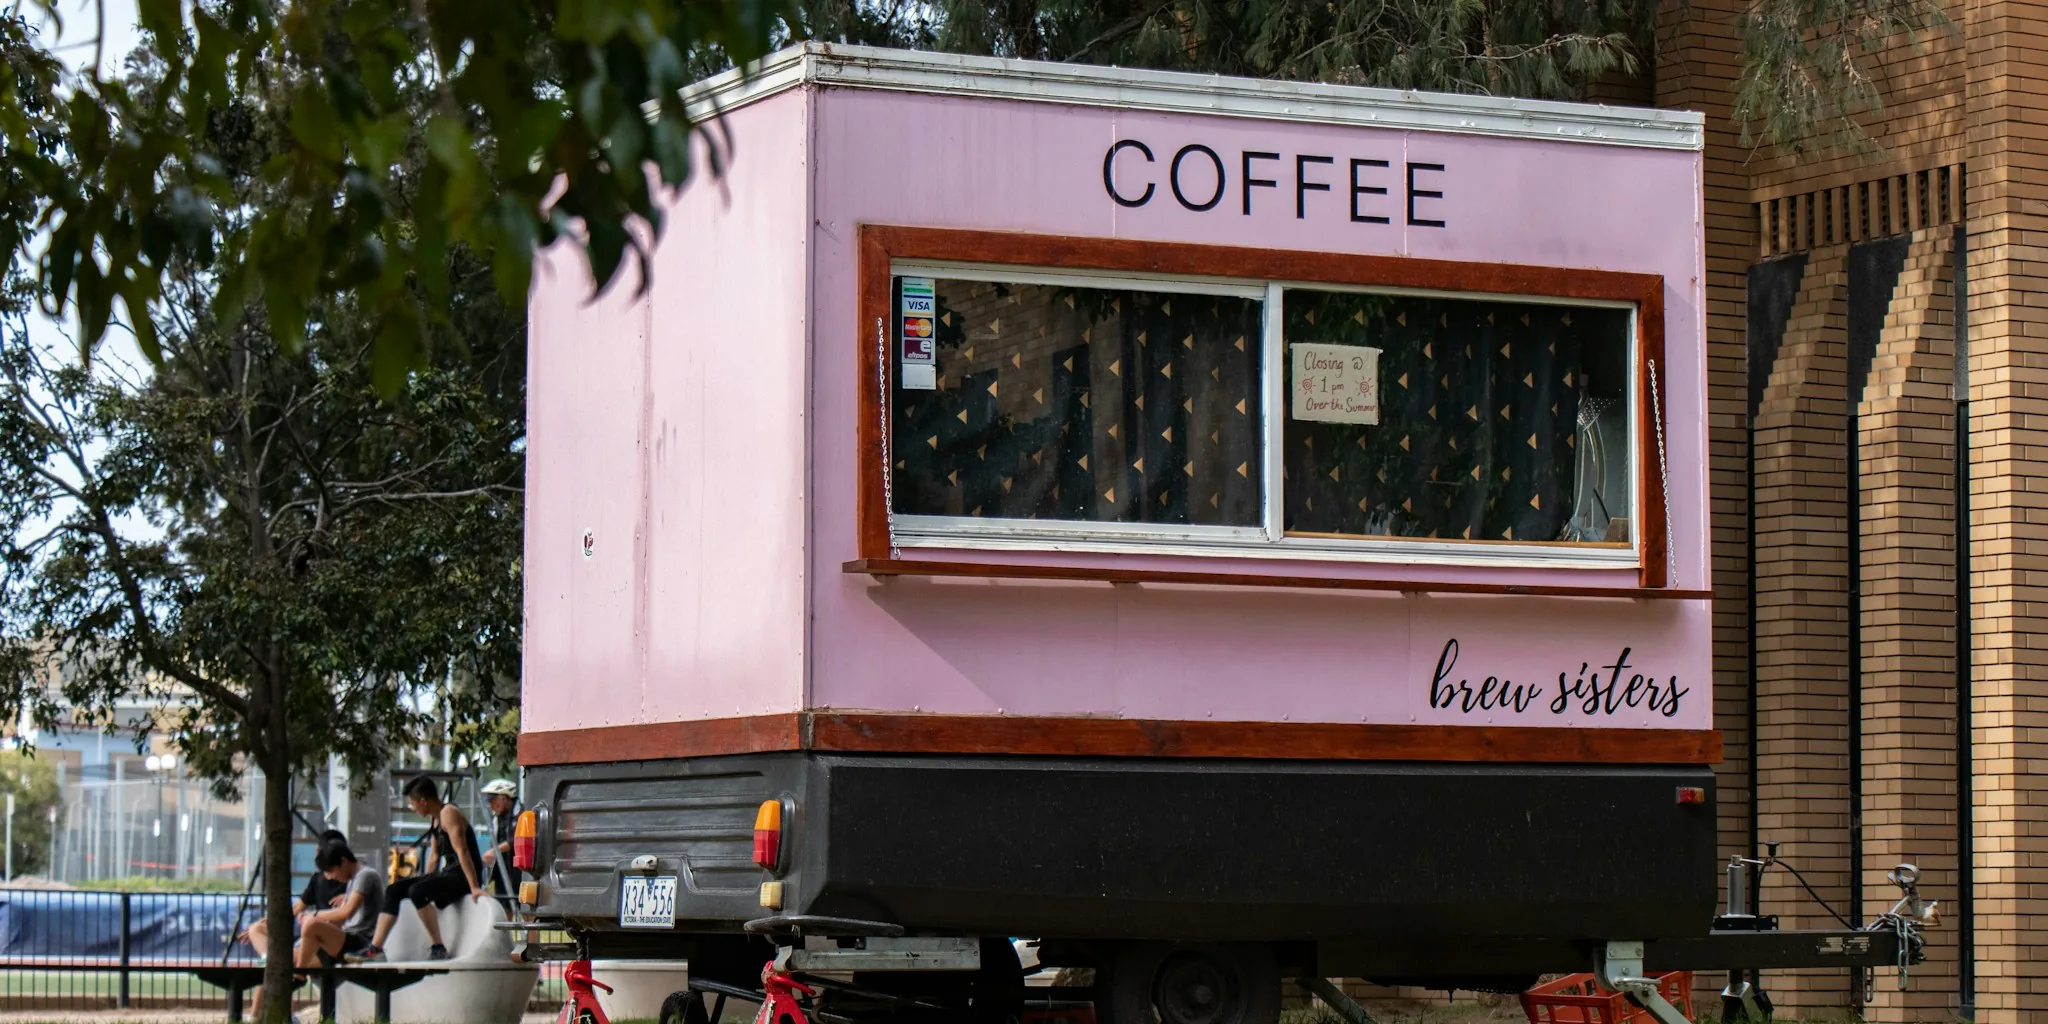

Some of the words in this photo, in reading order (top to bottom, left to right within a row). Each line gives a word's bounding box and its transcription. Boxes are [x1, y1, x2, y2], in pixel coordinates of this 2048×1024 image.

[1103, 139, 1446, 228] COFFEE
[907, 300, 930, 310] VISA
[1304, 351, 1344, 378] Closing
[1352, 356, 1364, 371] @
[1320, 376, 1328, 393] 1
[1332, 383, 1344, 395] pm
[1306, 397, 1329, 411] Over
[1329, 398, 1344, 411] the
[1345, 397, 1377, 413] Summer
[1429, 638, 1542, 714] brew
[1550, 647, 1690, 717] sisters
[623, 885, 645, 915] X34
[652, 885, 673, 915] 556
